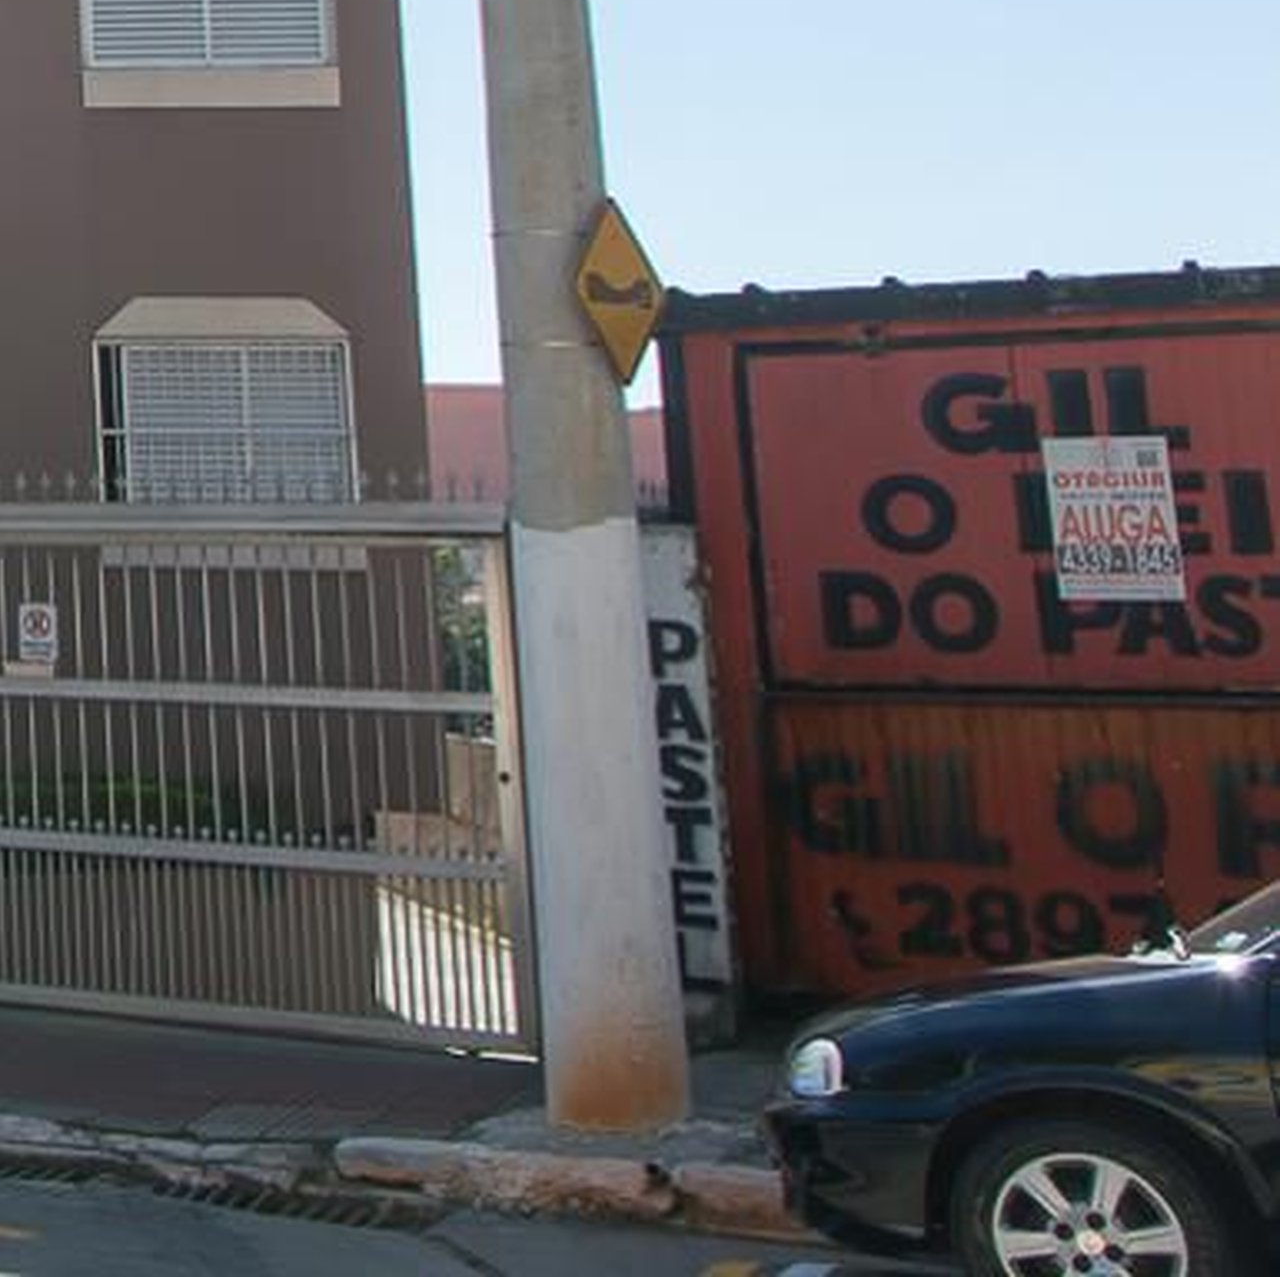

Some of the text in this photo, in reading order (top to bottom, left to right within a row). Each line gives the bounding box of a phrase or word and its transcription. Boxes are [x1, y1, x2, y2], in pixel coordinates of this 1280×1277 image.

[922, 366, 1190, 454] GIL
[861, 475, 956, 554] O
[1060, 505, 1169, 543] ALUGA
[819, 571, 1280, 658] DO PAS
[647, 619, 726, 994] PASTEL
[795, 748, 1011, 867] GIL
[1056, 759, 1169, 869] O
